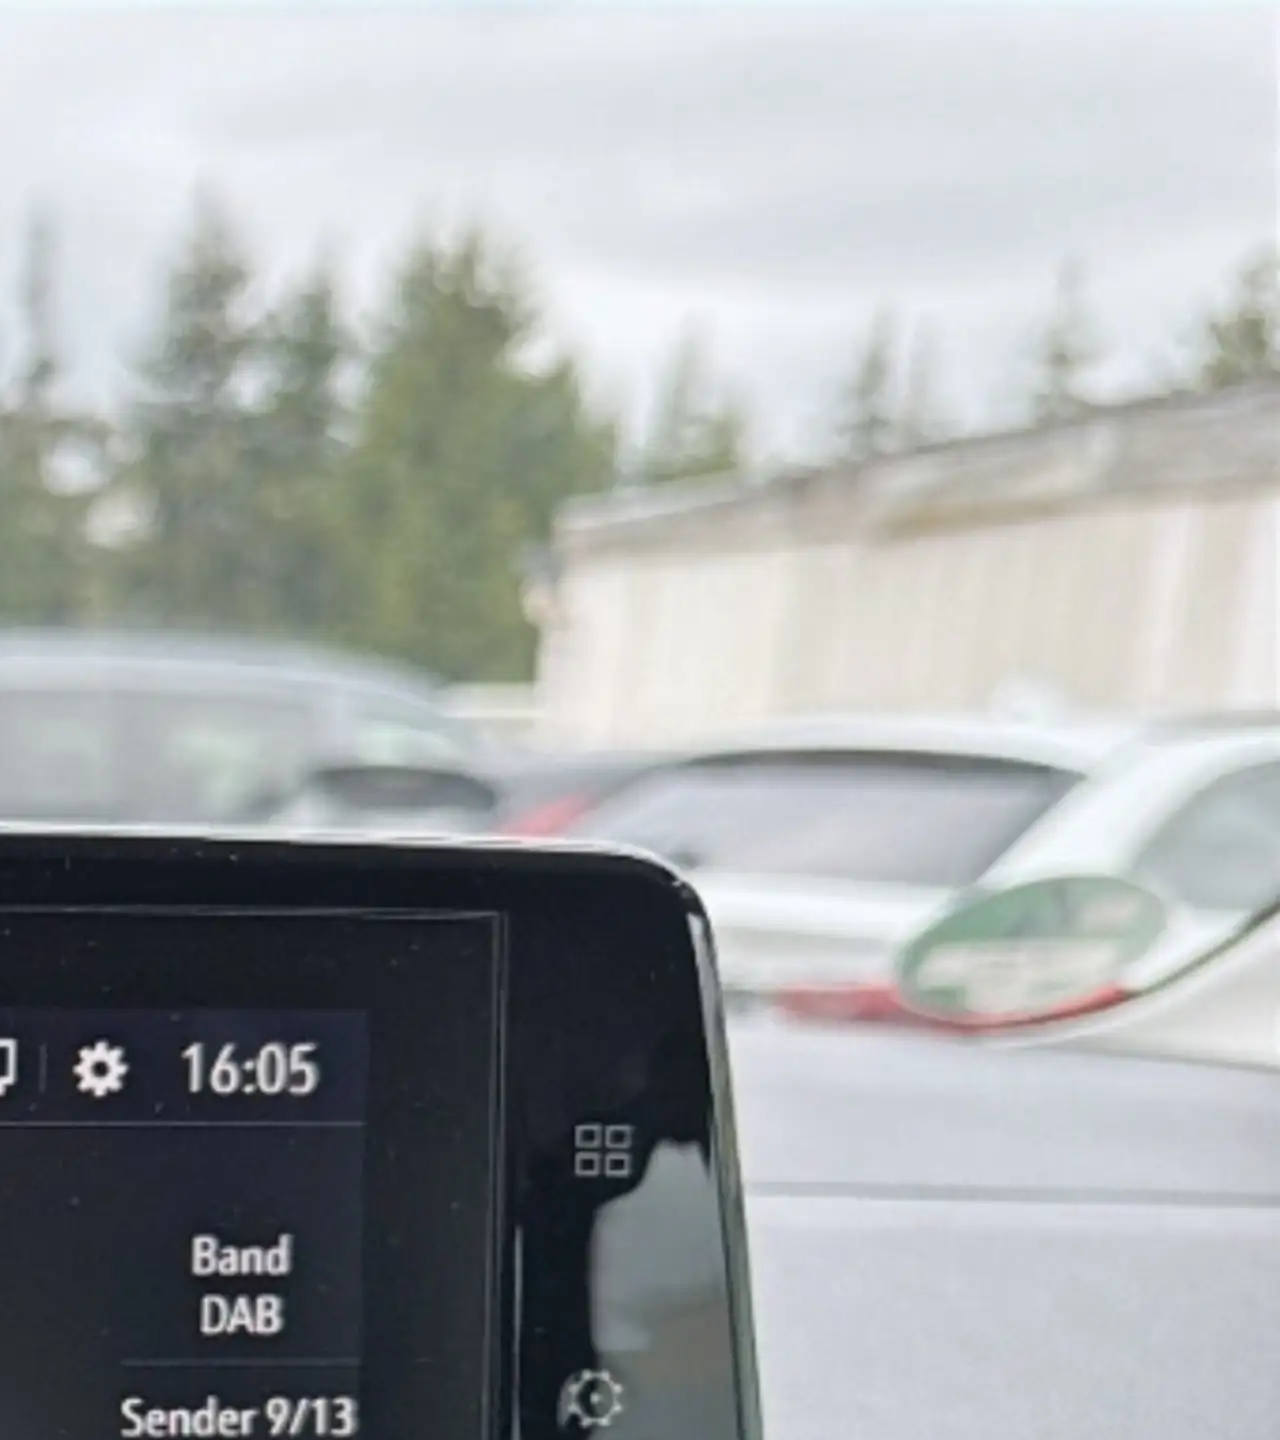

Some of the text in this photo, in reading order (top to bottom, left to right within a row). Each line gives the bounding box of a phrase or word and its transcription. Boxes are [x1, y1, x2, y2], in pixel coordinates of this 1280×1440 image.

[183, 1042, 318, 1095] 16:05
[192, 1233, 291, 1276] Band
[200, 1294, 282, 1335] DAB
[121, 1395, 357, 1438] Sender 9/13
